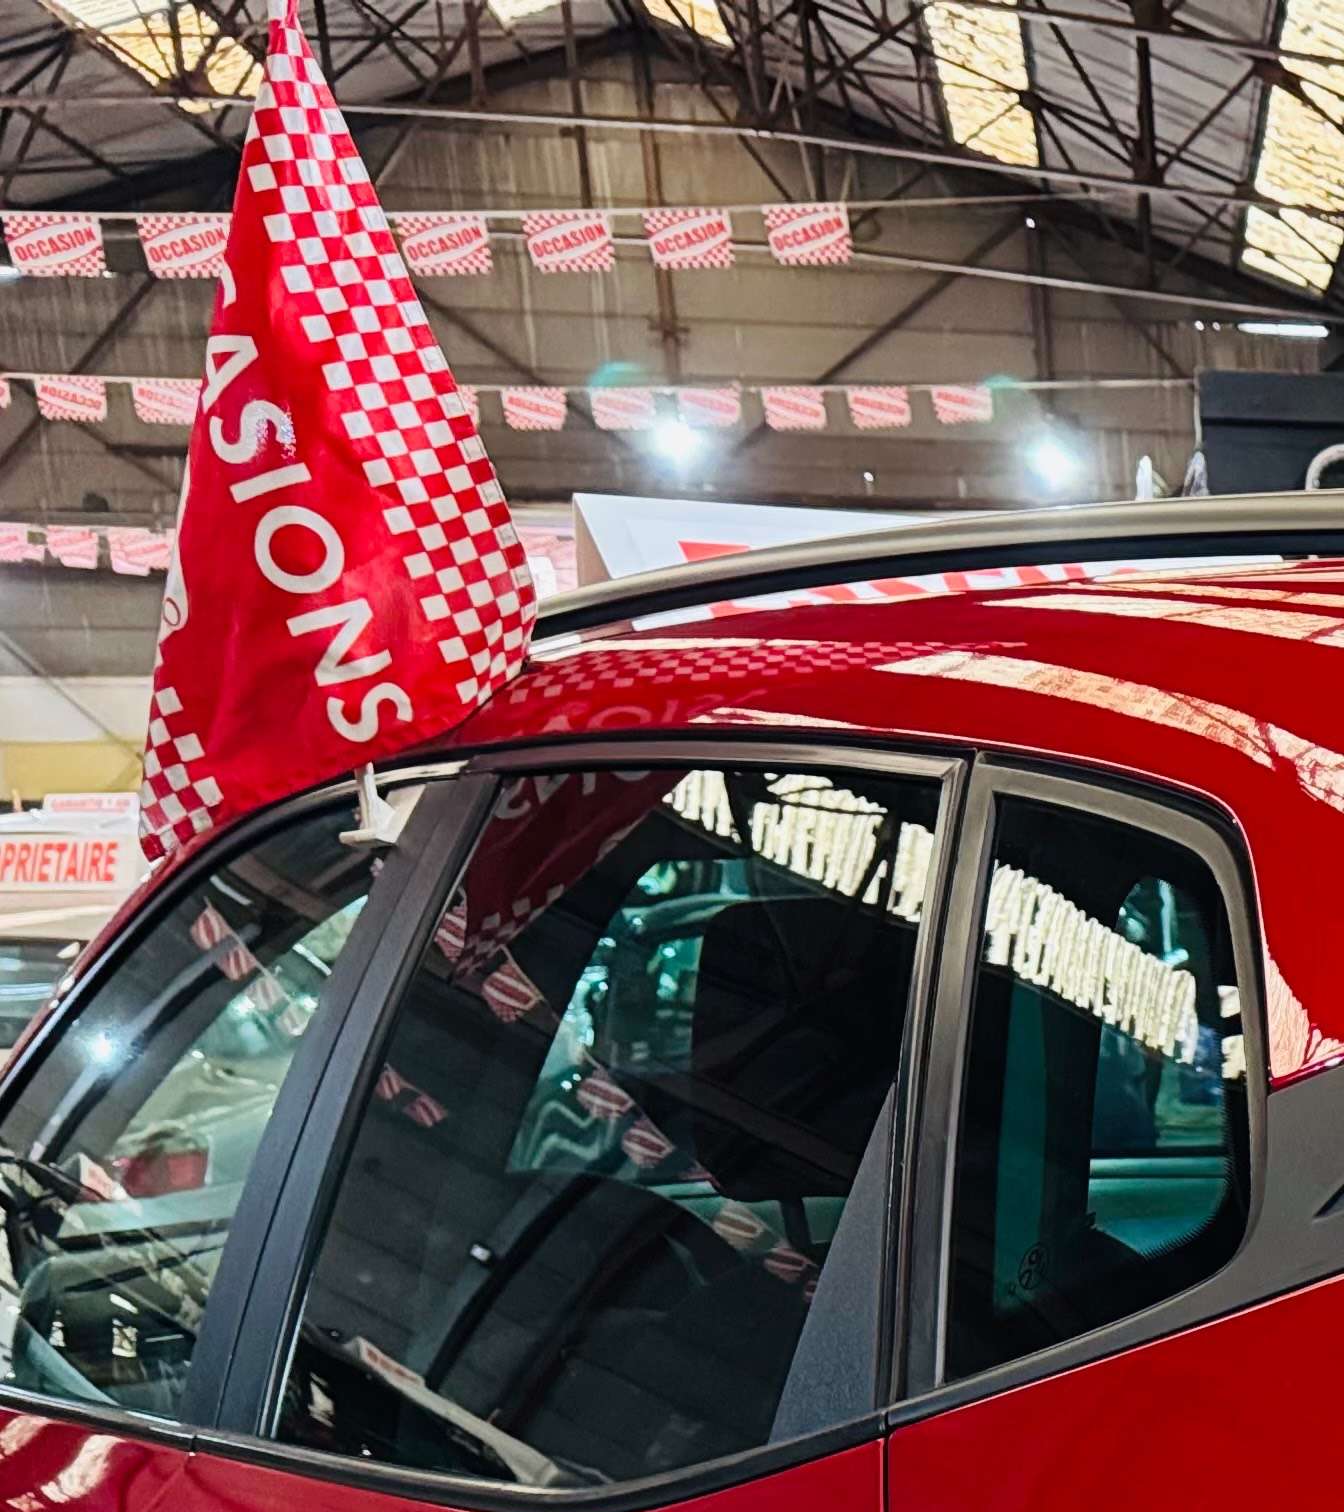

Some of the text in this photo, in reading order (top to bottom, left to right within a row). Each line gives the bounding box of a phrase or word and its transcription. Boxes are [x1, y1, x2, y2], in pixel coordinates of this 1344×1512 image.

[15, 227, 97, 262] OCCASION
[149, 227, 226, 263] OCCASION
[407, 225, 484, 262] OCCASION
[531, 223, 607, 259] OCCASION
[654, 219, 727, 256] OCCASION
[773, 217, 844, 252] OCCASION
